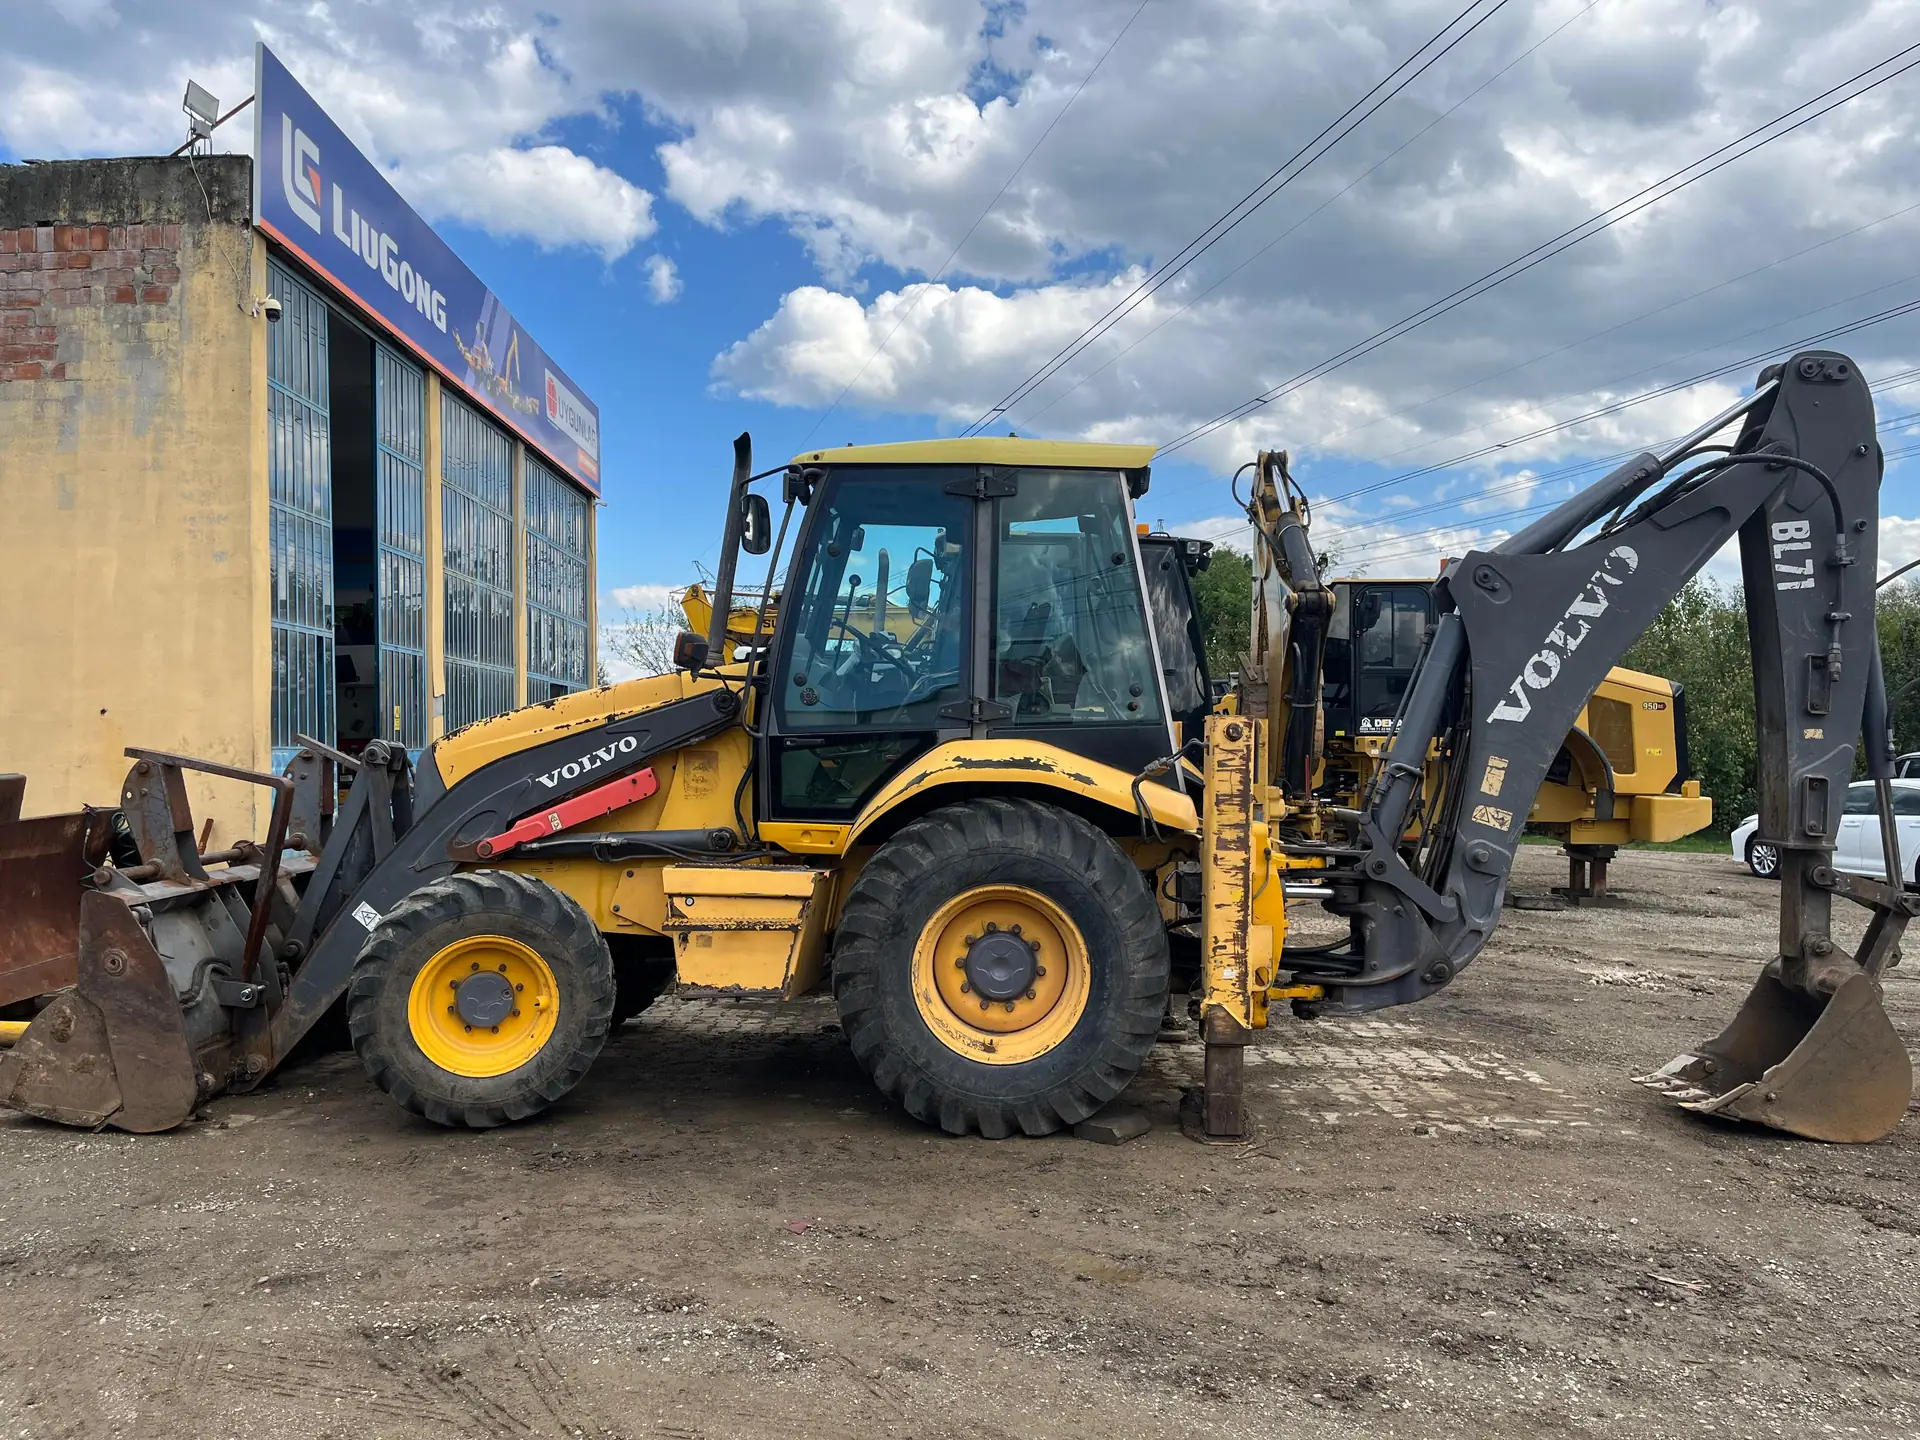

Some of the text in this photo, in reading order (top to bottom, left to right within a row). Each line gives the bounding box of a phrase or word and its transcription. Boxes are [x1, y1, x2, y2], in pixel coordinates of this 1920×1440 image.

[1771, 520, 1815, 590] BL71
[1486, 545, 1639, 724] VOLVO
[1642, 702, 1658, 710] 950
[535, 736, 638, 789] VOLVO
